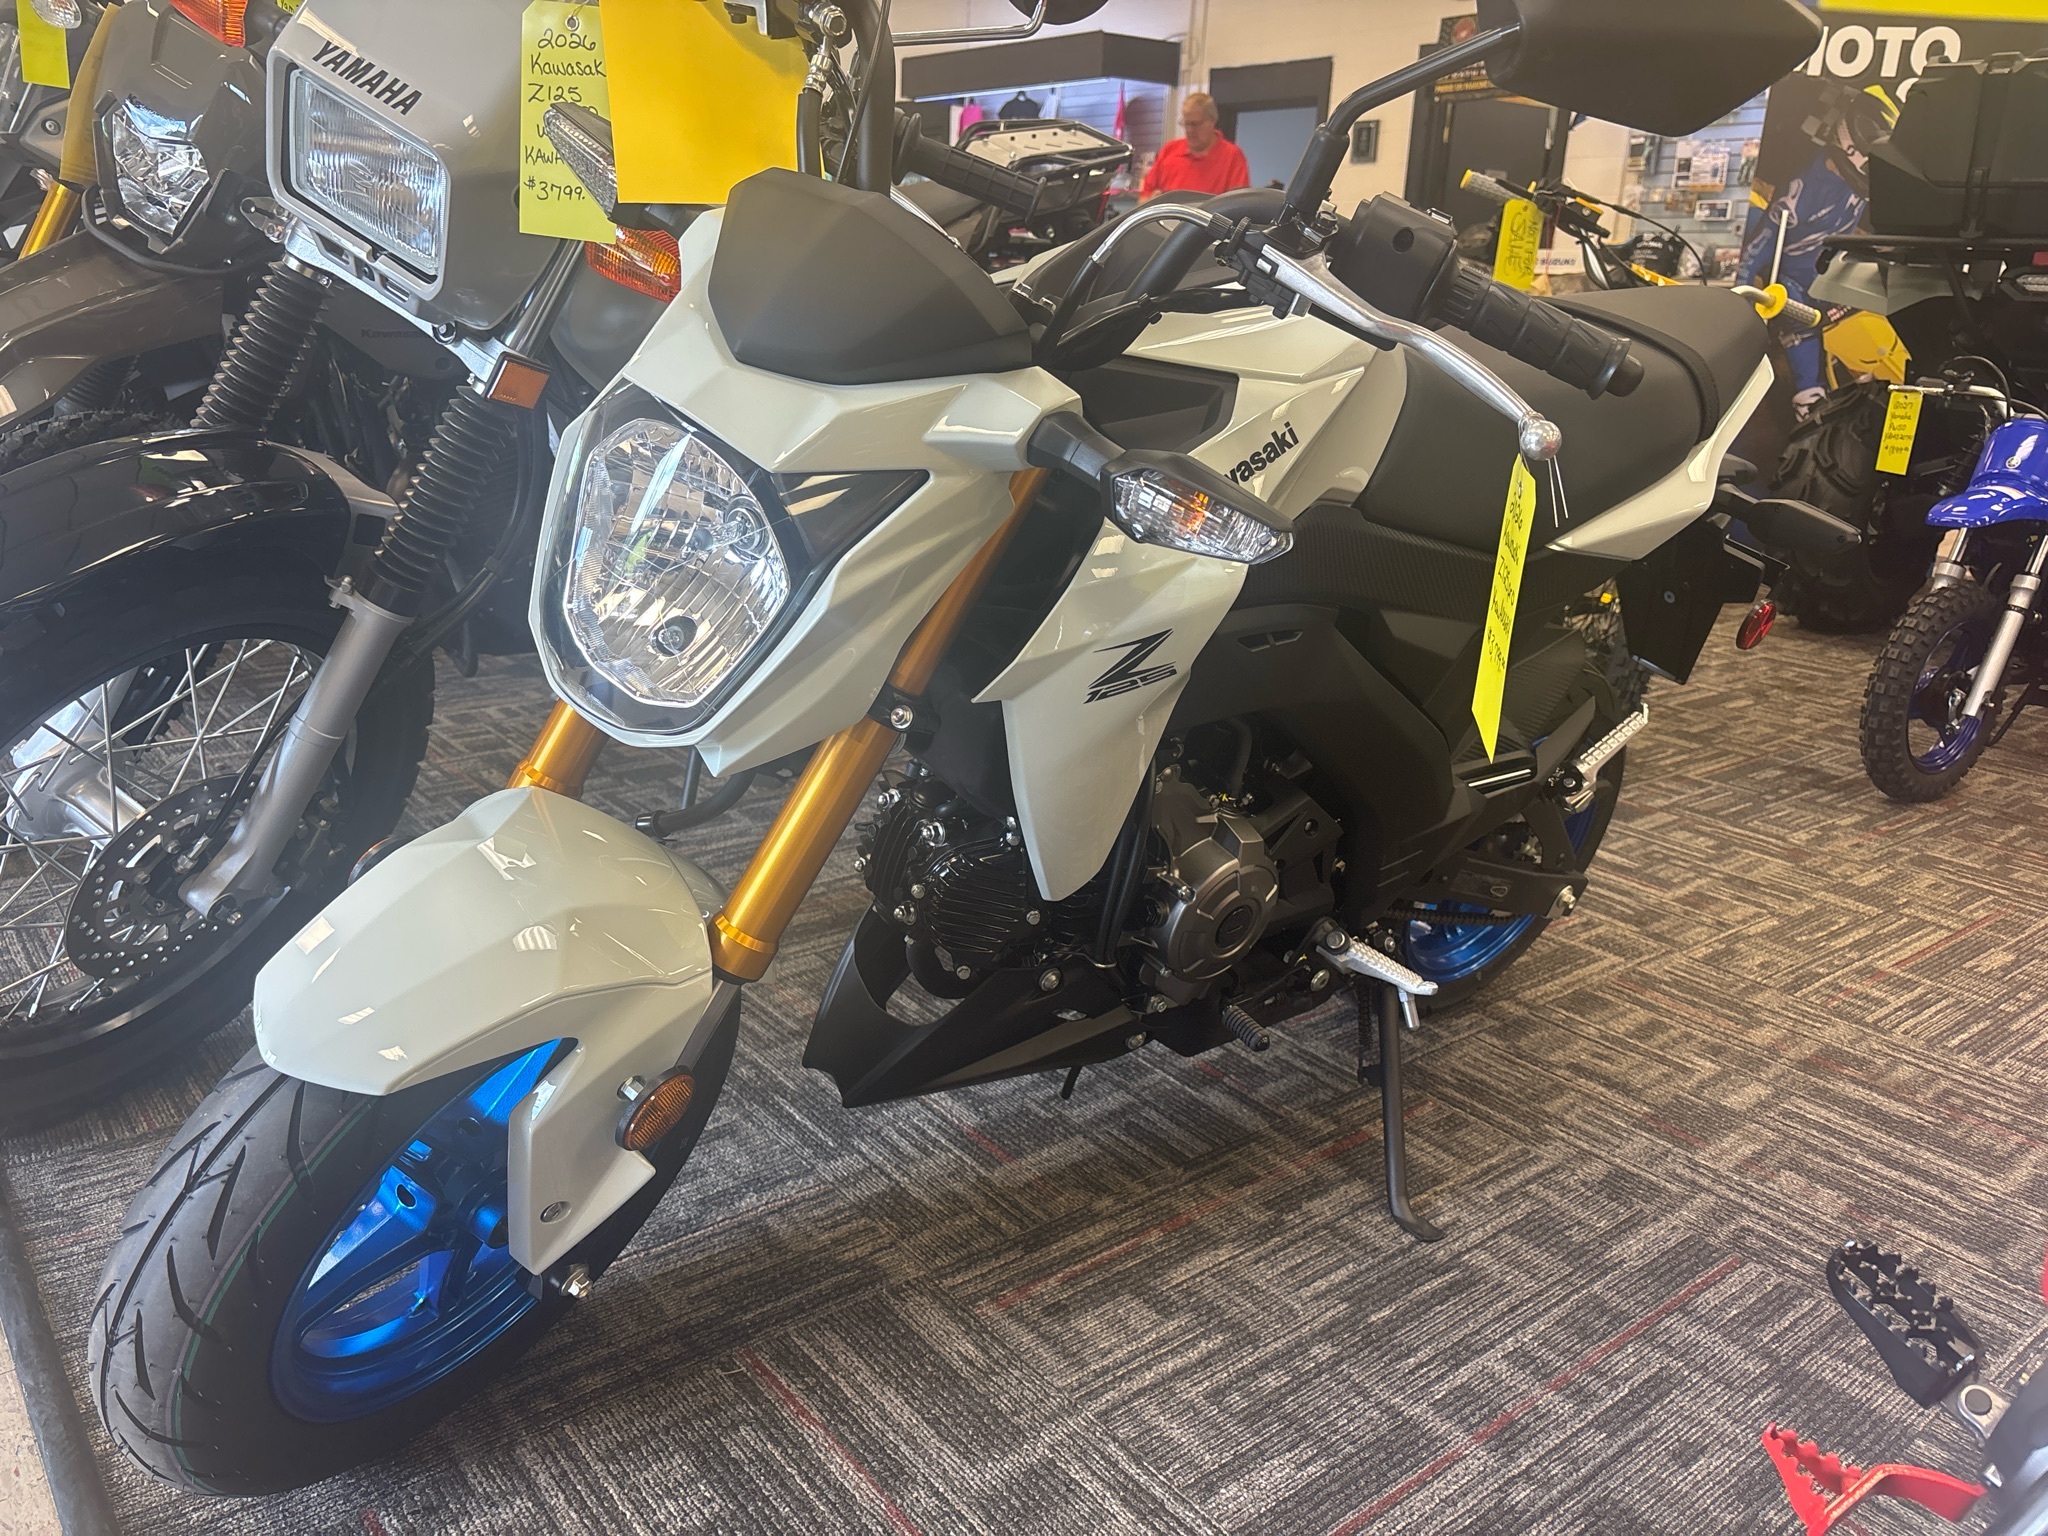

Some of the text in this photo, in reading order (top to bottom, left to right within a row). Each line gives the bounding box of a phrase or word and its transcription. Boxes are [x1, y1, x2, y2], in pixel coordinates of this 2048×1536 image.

[538, 28, 597, 51] 2026
[312, 40, 423, 116] YAMAHA
[531, 52, 607, 77] Kawasak
[528, 83, 582, 102] Z125
[1224, 421, 1299, 485] asaki
[1087, 628, 1176, 689] Z
[1083, 665, 1178, 704] 125
